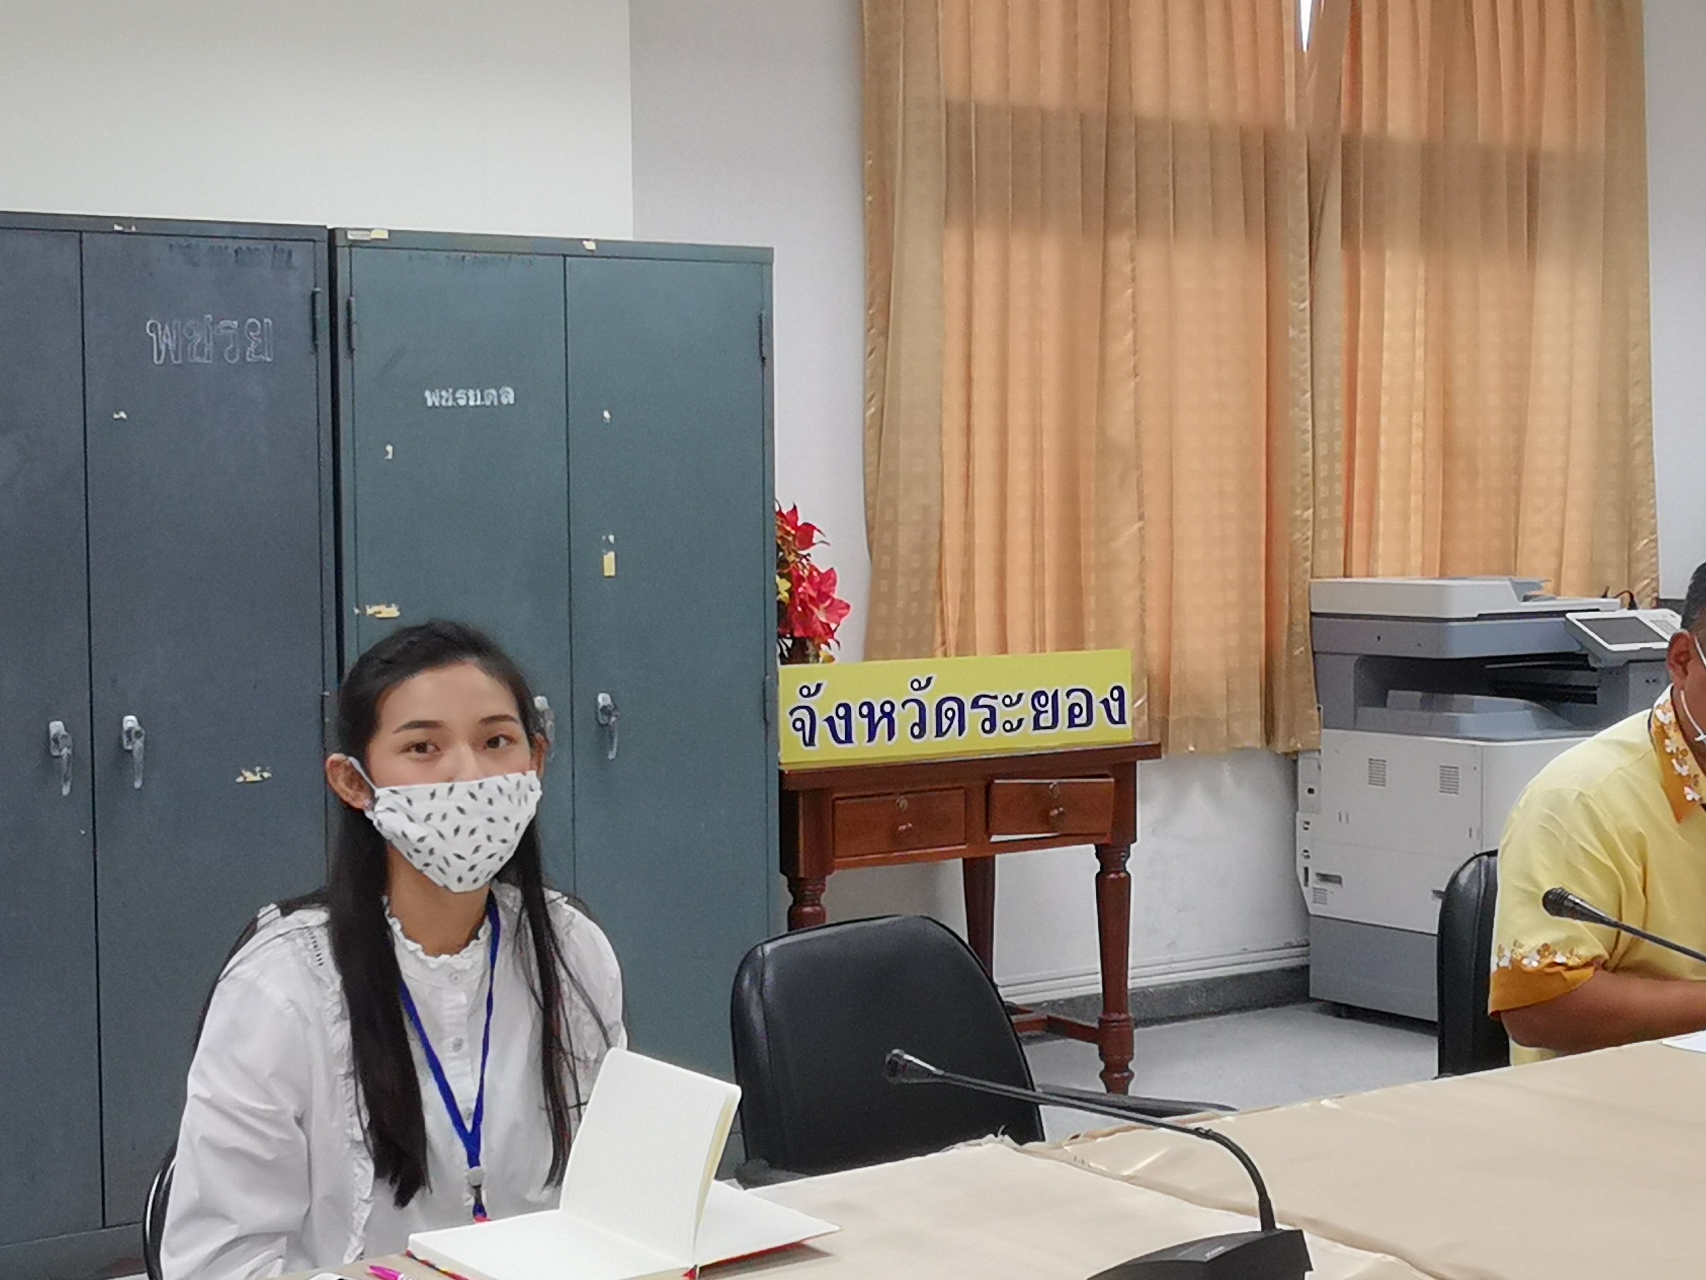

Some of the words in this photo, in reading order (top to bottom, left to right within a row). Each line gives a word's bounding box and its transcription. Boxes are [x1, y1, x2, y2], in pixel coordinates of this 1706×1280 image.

[787, 675, 1129, 748] จังหวัดระยอง
